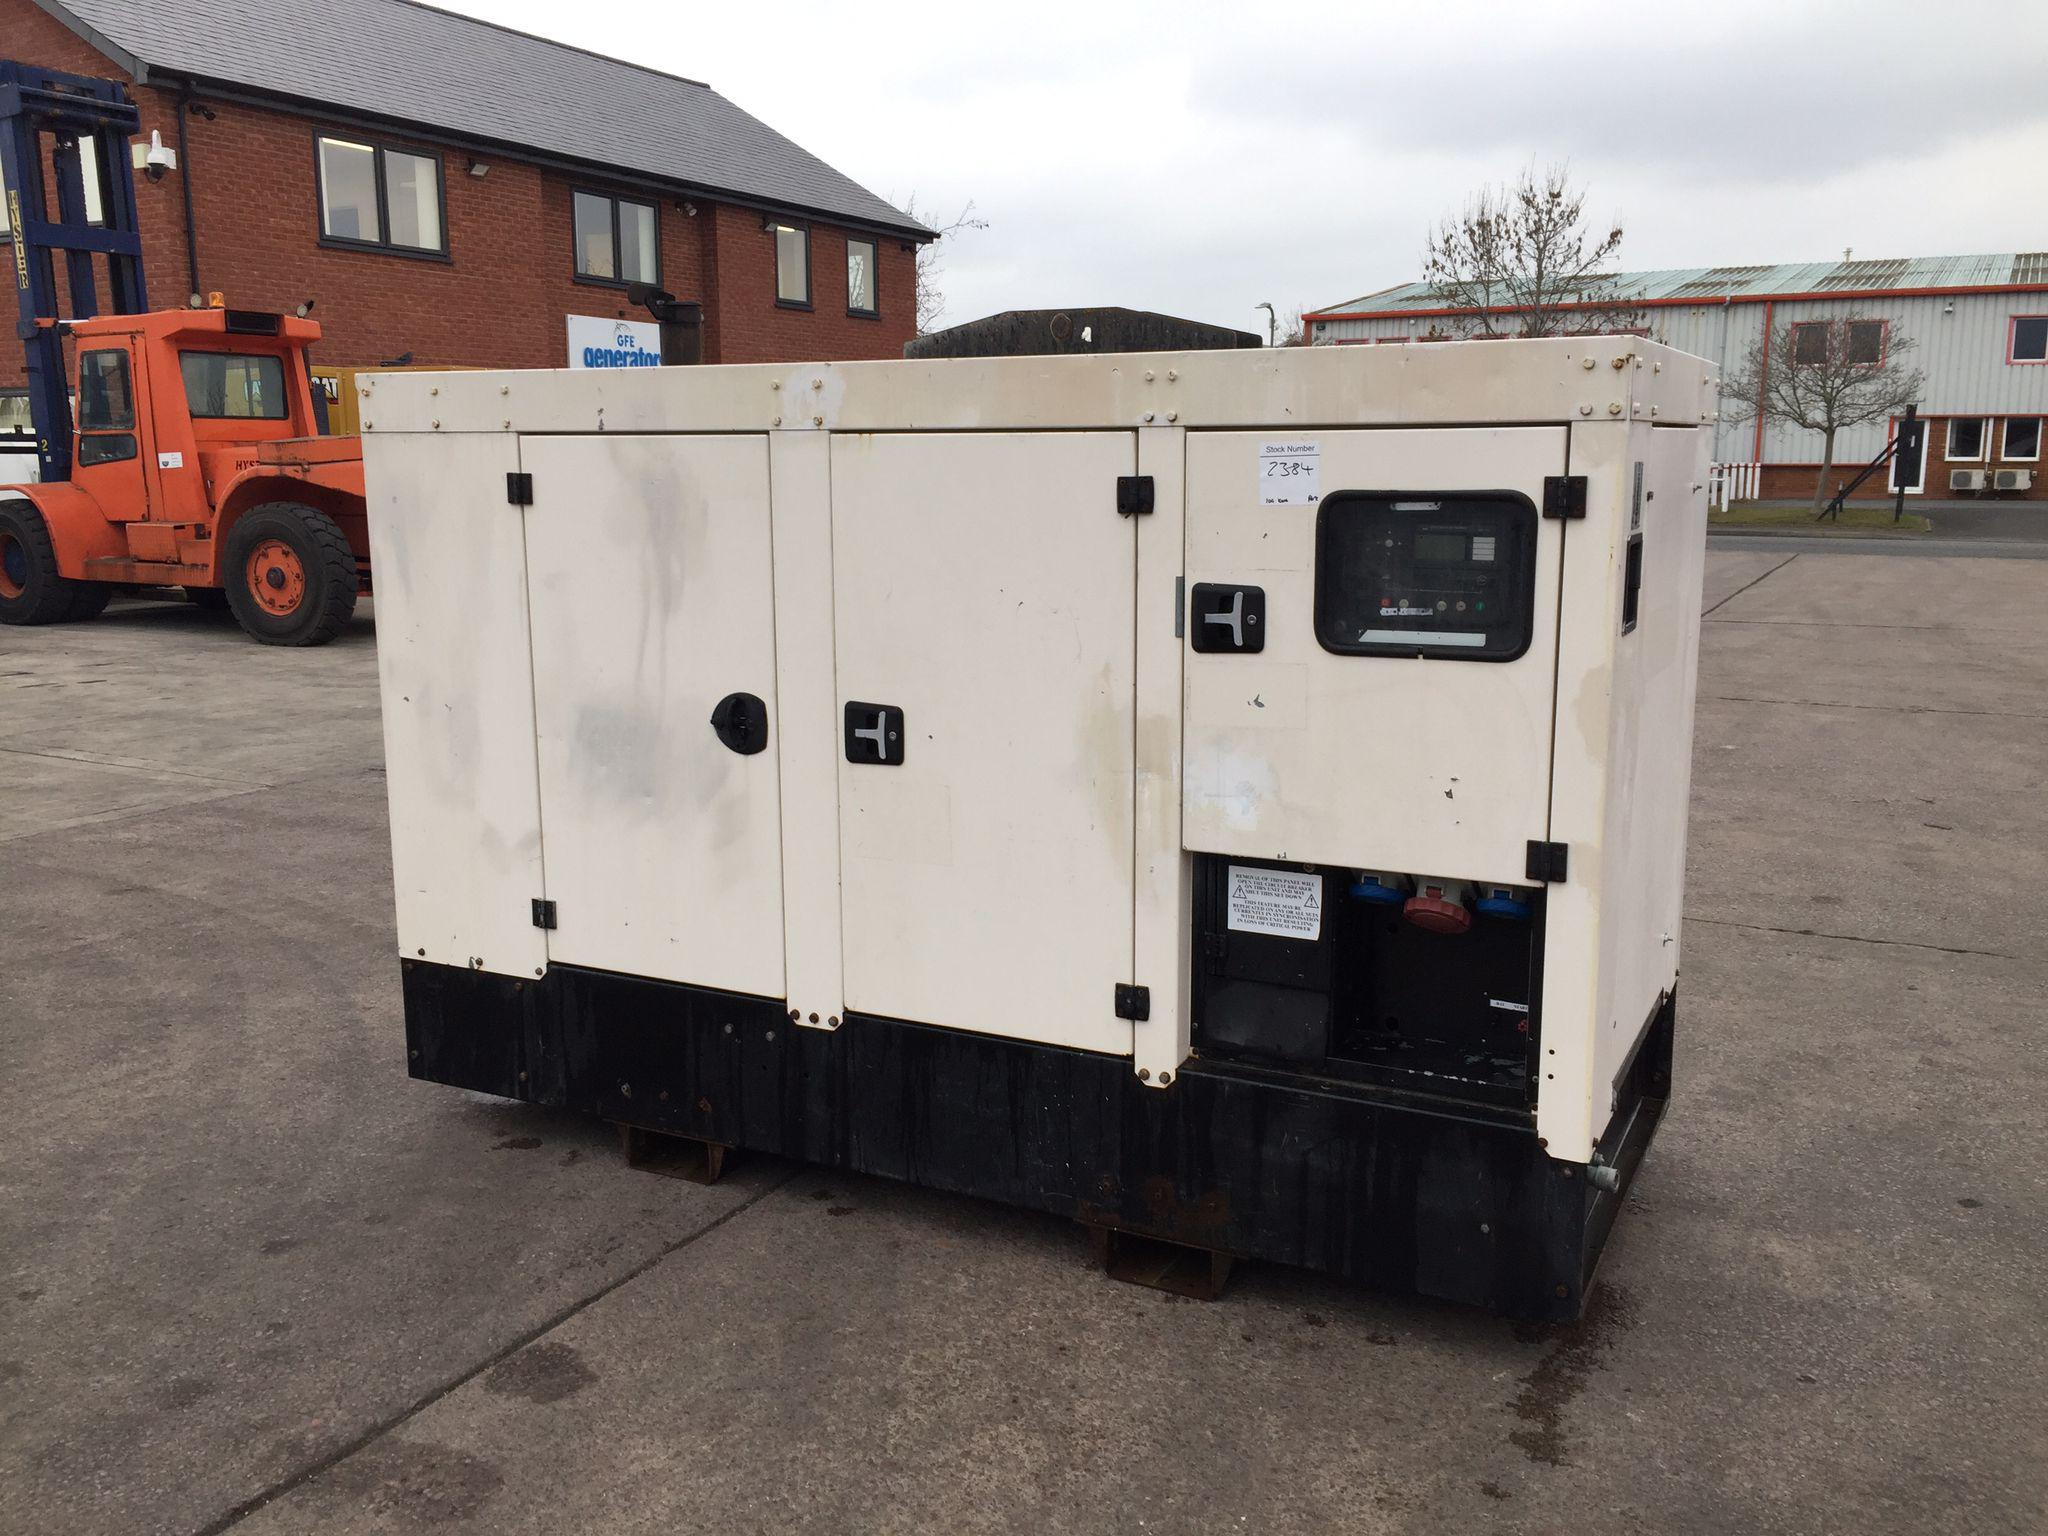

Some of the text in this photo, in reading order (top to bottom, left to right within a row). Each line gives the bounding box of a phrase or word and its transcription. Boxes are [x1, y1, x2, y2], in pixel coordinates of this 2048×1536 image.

[617, 335, 635, 348] GFE
[584, 347, 661, 367] generator
[1287, 445, 1315, 453] Number
[1267, 461, 1314, 477] 2384
